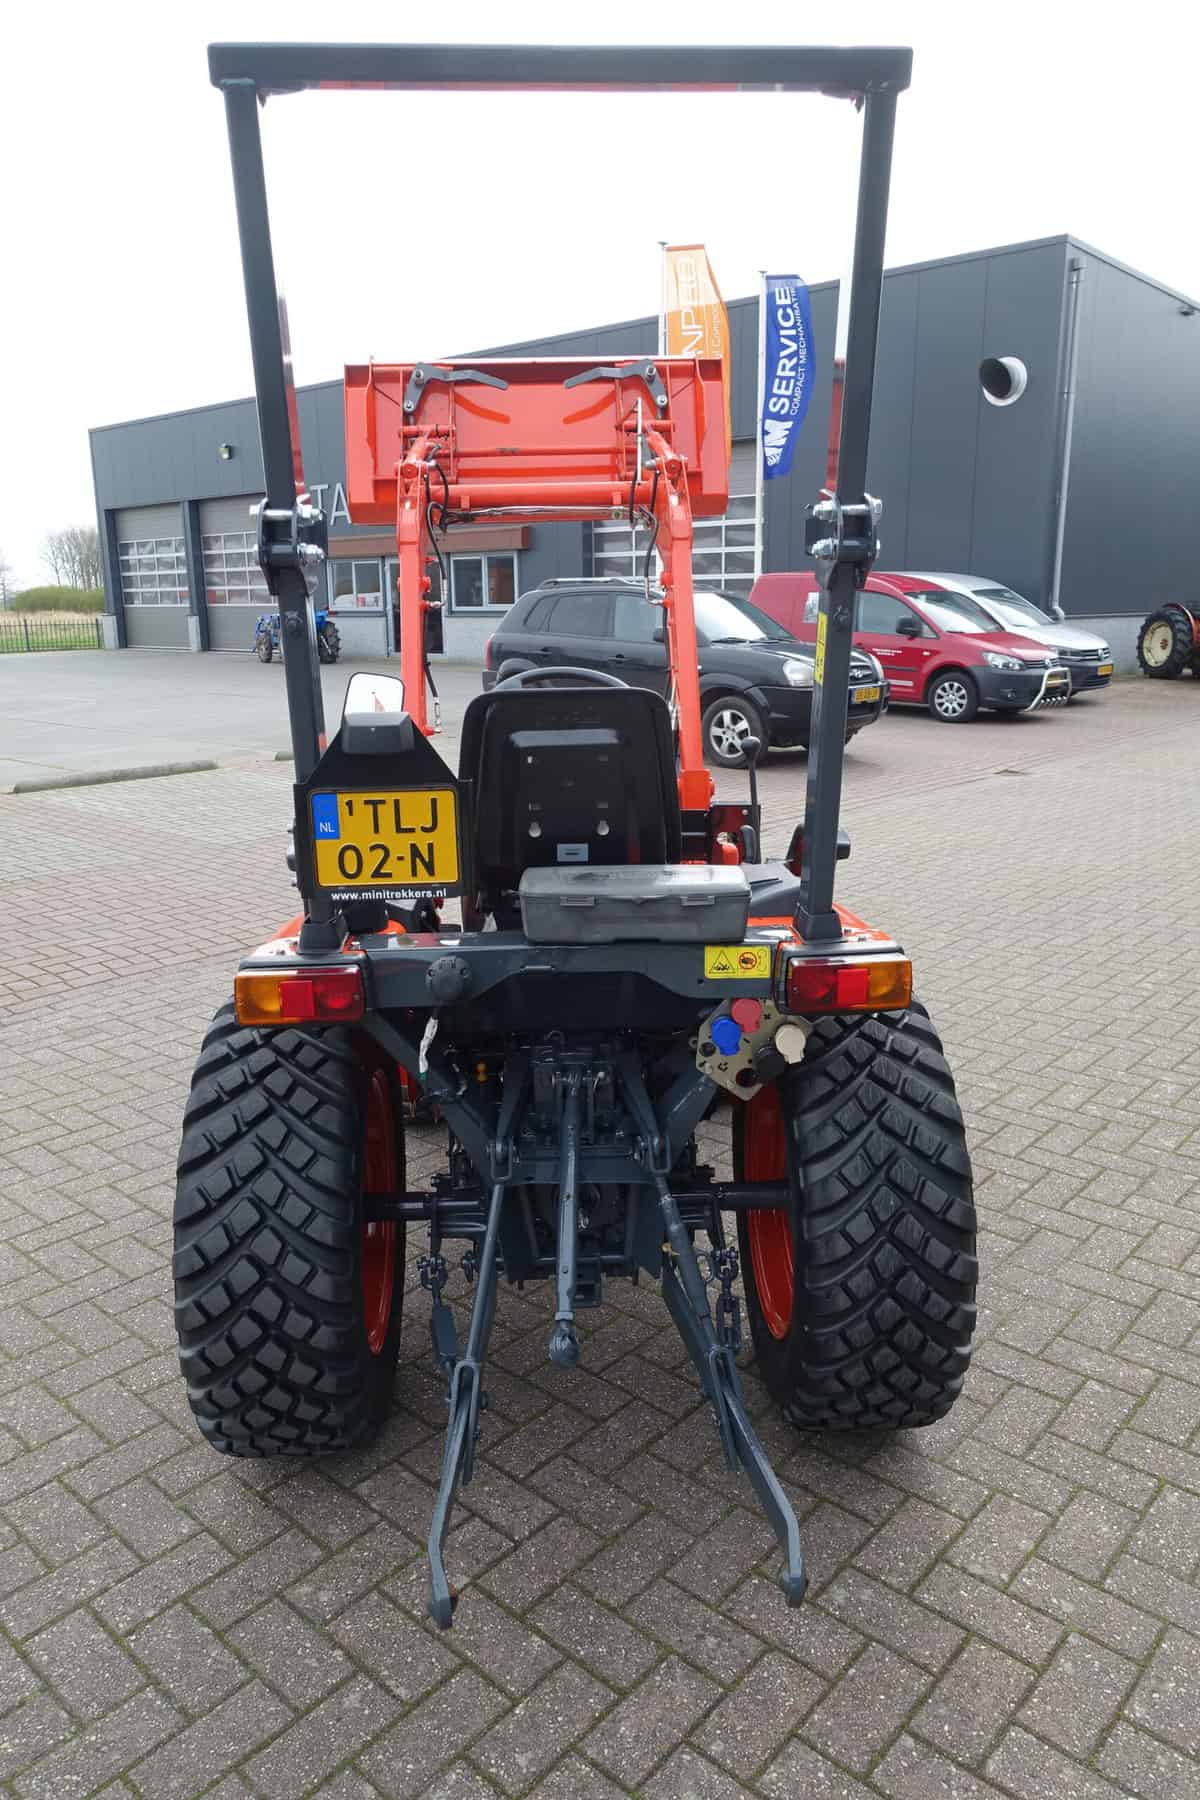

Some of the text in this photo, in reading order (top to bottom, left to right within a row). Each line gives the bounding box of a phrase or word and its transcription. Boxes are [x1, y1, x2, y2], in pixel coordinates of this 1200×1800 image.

[769, 287, 798, 415] SERVICE
[790, 367, 808, 416] COMPACT
[319, 821, 336, 833] NL
[331, 888, 447, 901] www.minitrekkers.nl
